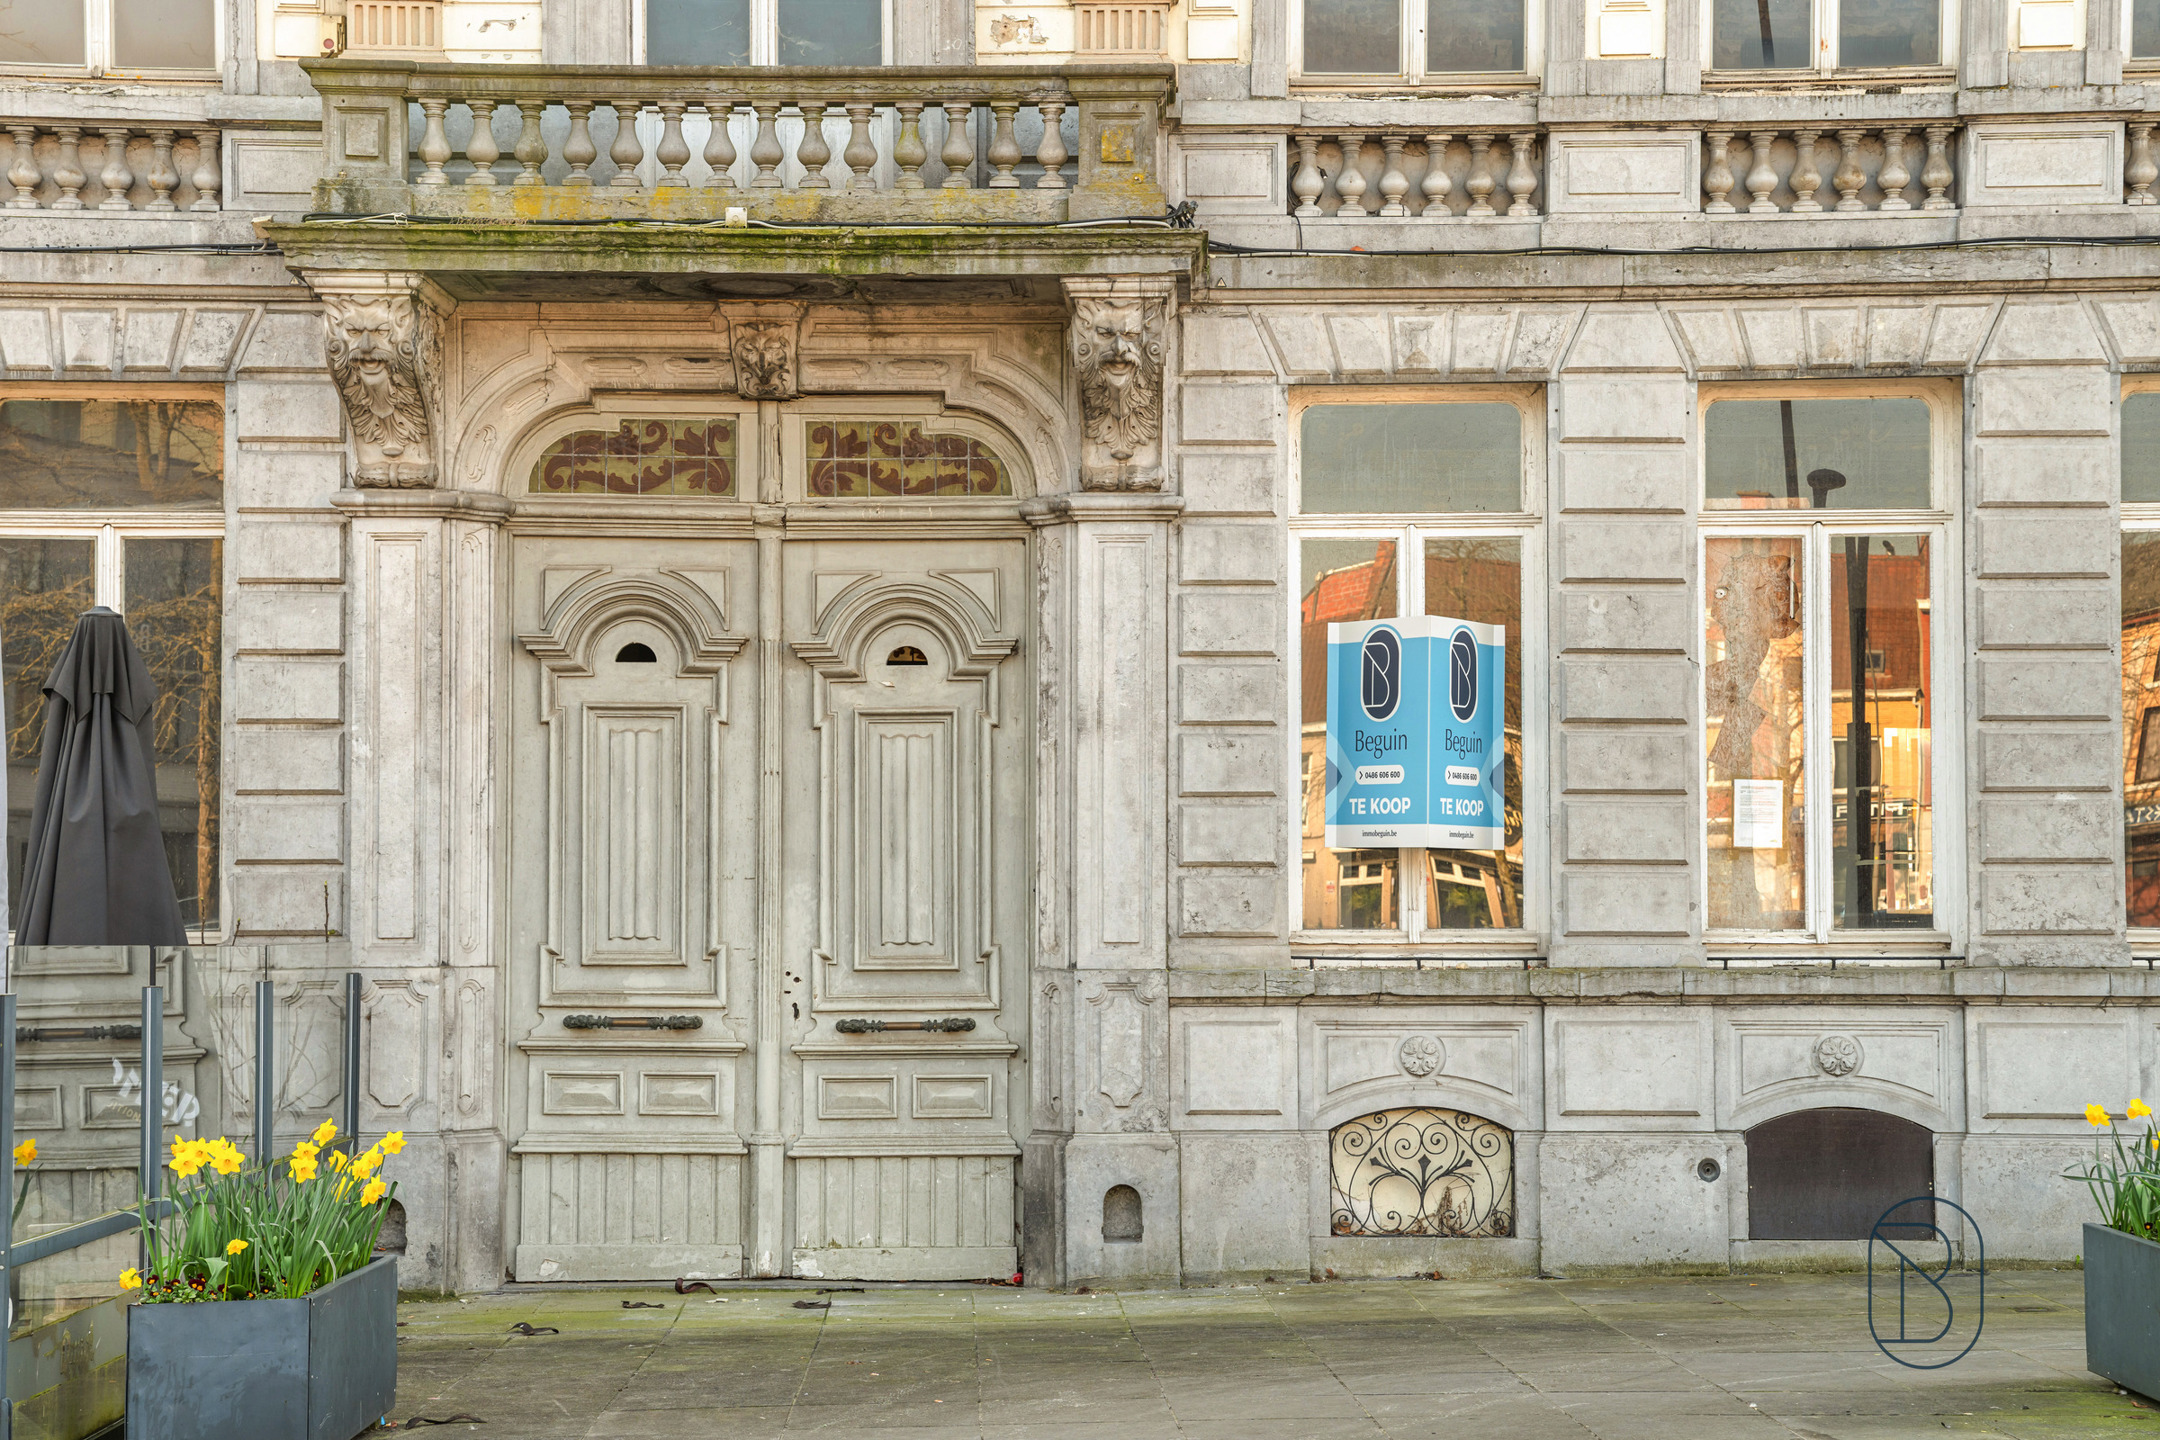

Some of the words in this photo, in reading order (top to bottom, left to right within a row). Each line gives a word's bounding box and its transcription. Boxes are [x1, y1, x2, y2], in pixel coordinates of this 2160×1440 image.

[1355, 728, 1408, 760] Beguin
[1445, 728, 1483, 760] Beguin
[1364, 771, 1379, 779] 0486
[1379, 771, 1390, 779] 606
[1390, 770, 1401, 778] 600
[1452, 772, 1462, 780] 0486
[1349, 797, 1367, 815] TE
[1370, 797, 1411, 815] KOOP
[1439, 797, 1453, 815] TE
[1455, 798, 1484, 817] KOOP
[1361, 829, 1398, 838] immobeguin.be
[1449, 830, 1474, 840] immobeguin.be
